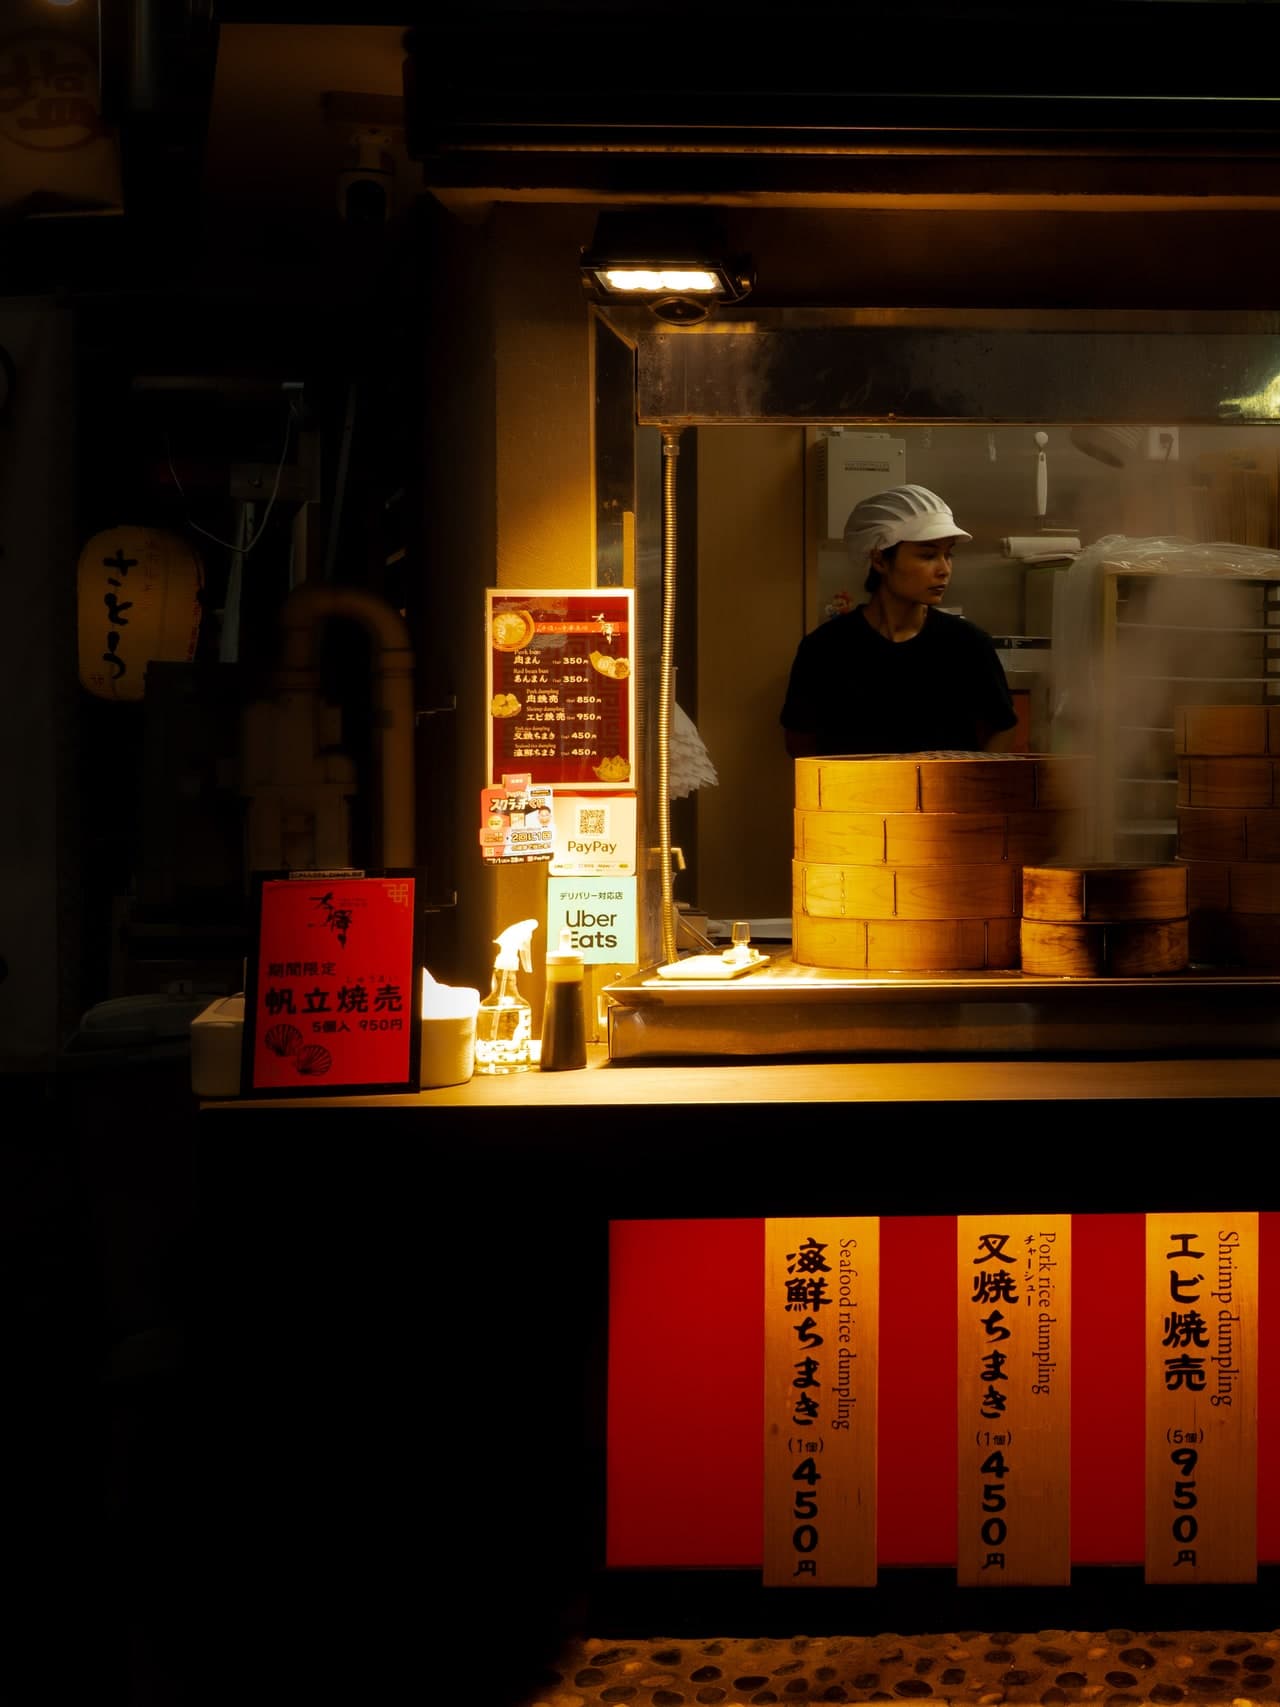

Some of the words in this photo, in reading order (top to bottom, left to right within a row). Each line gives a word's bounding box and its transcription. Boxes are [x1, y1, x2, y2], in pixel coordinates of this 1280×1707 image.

[104, 549, 138, 680] さとう
[514, 674, 549, 683] あんまん
[562, 675, 589, 683] 350円
[562, 657, 589, 665] 350円
[568, 841, 617, 855] PayPay
[559, 892, 624, 901] デリバリー対応店
[566, 909, 617, 928] Uber
[269, 962, 336, 977] 期間限定
[265, 984, 403, 1015] 帆立焼売
[312, 1020, 351, 1033] 5個入
[359, 1019, 403, 1032] 950円
[1038, 1231, 1056, 1272] Pork
[1211, 1230, 1240, 1305] Shrimp
[838, 1238, 858, 1307] Seafood
[1038, 1274, 1052, 1309] rice
[838, 1309, 852, 1343] rice
[971, 1233, 1020, 1419] 叉焼ちまき
[1162, 1233, 1210, 1391] エビ焼売
[784, 1237, 833, 1426] 海鮮ちまき
[1031, 1311, 1057, 1396] dumpling
[1210, 1310, 1240, 1407] dumpling
[832, 1346, 857, 1431] dumpling
[788, 1438, 824, 1454] (1個)
[976, 1432, 1012, 1448] (1個)
[1166, 1428, 1204, 1445] (5個)
[792, 1457, 821, 1577] 450円
[980, 1450, 1010, 1570] 450円
[1170, 1448, 1199, 1567] 950円
